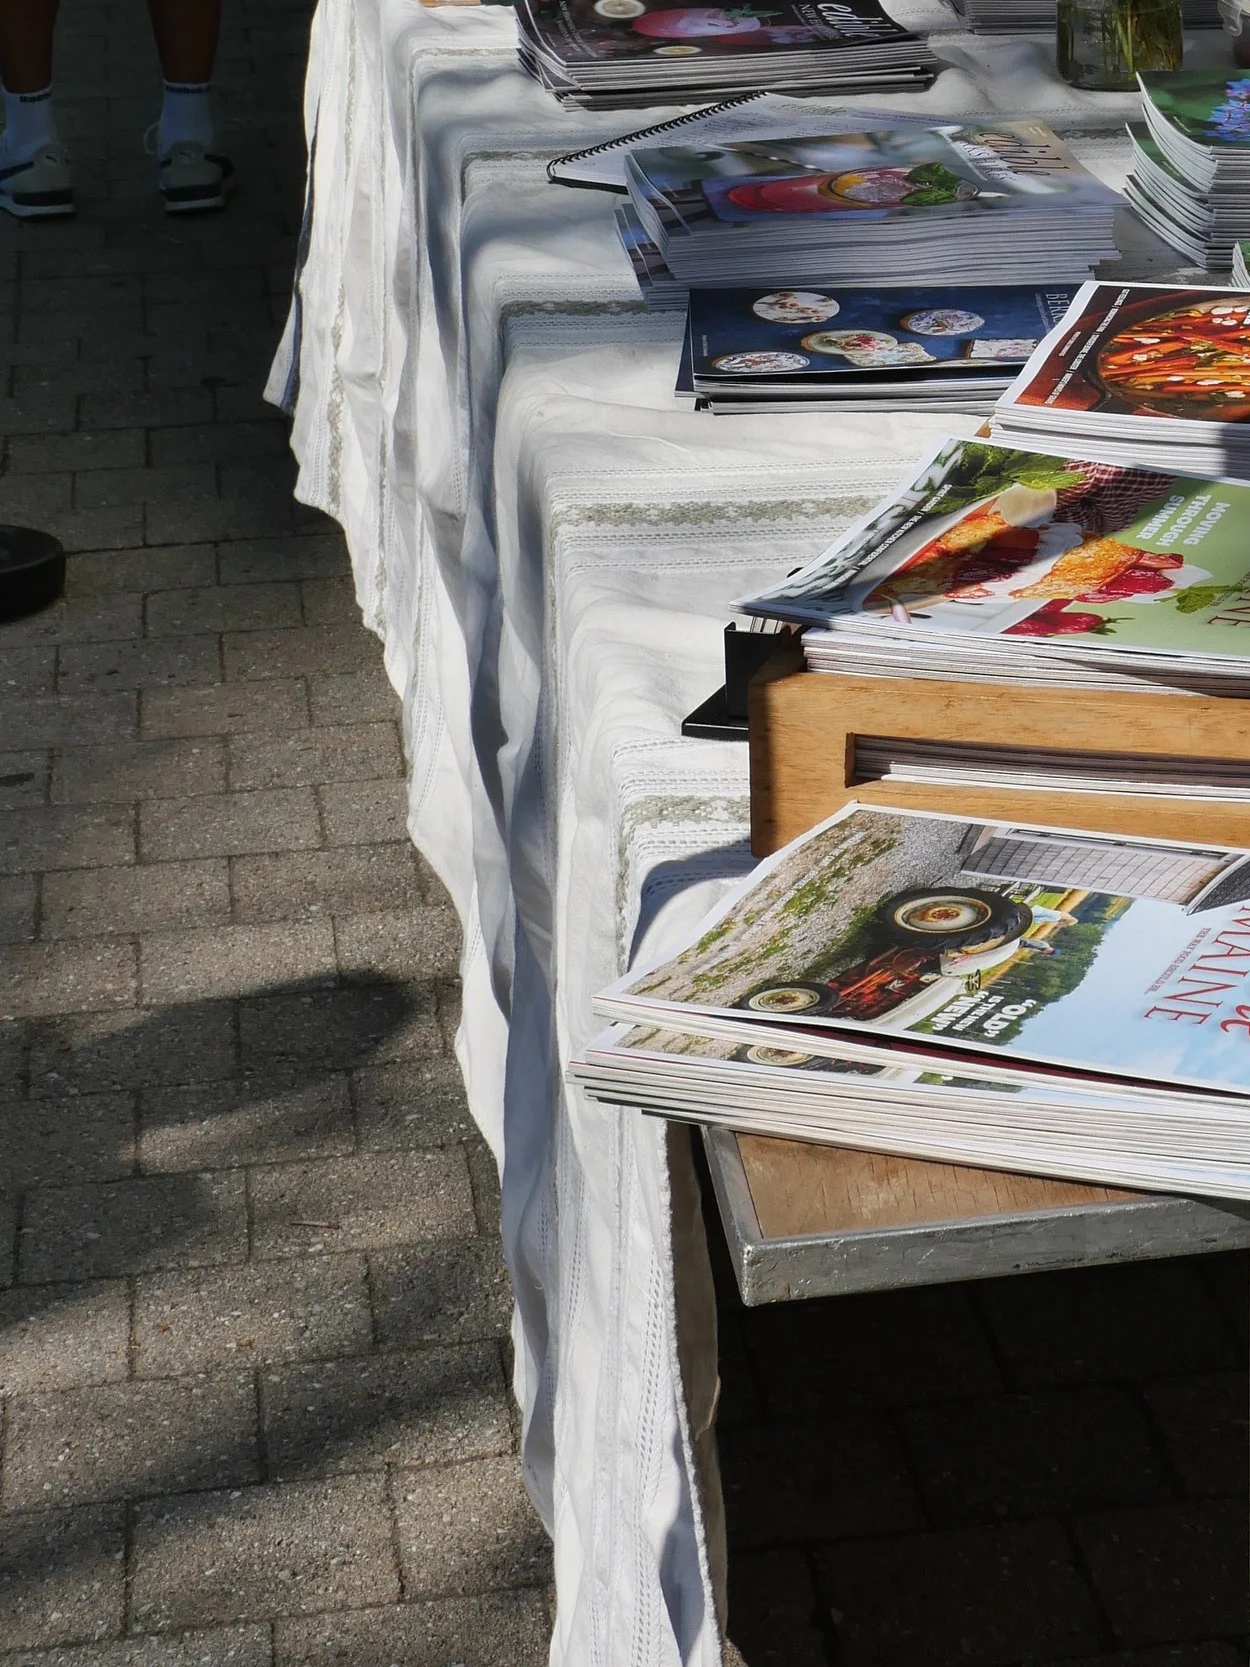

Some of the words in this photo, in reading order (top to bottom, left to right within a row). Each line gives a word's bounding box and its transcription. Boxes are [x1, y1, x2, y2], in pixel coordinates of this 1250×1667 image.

[818, 3, 896, 40] edible
[977, 131, 1070, 179] edible
[1133, 492, 1191, 541] SUMMER
[1156, 492, 1213, 548] THROUGH
[1183, 501, 1230, 547] MOVING
[1183, 937, 1204, 950] WAY
[1193, 926, 1215, 938] THE
[1170, 950, 1193, 964] FOOD
[1151, 964, 1181, 984] SHOULD
[929, 991, 984, 1036] “NEW”
[971, 1001, 996, 1018] THE
[985, 995, 1006, 1004] IS
[951, 1014, 978, 1032] NEW
[980, 997, 1039, 1043] “OLD”
